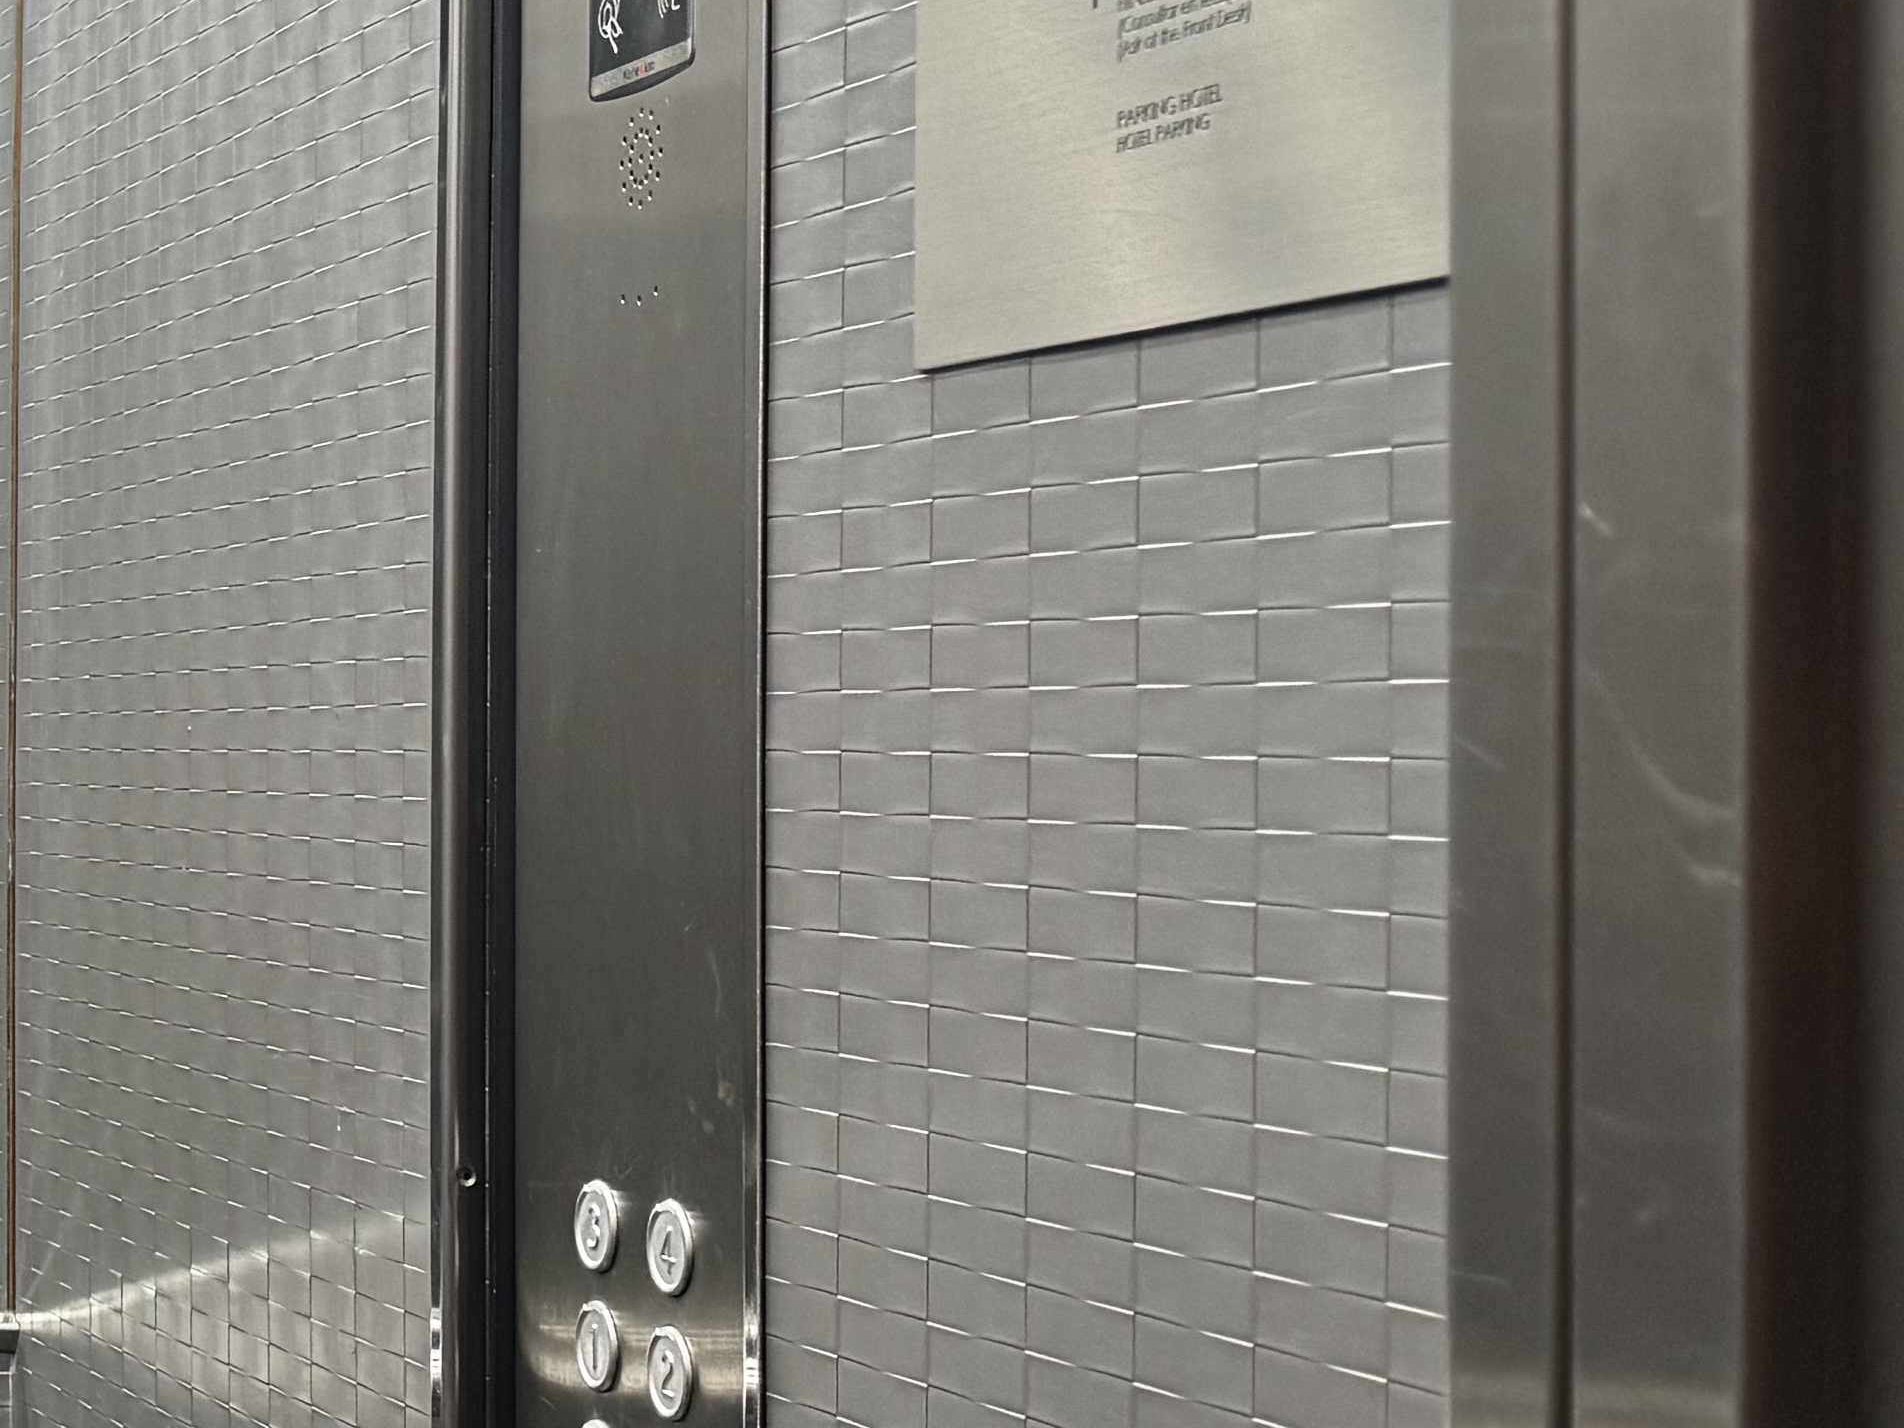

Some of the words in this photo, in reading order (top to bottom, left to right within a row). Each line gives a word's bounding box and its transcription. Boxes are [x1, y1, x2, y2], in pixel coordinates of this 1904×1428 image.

[1116, 96, 1177, 129] PARKING
[1178, 83, 1223, 112] HOTEL
[1116, 128, 1153, 153] HOTEL
[1154, 112, 1211, 142] PARKING
[585, 1202, 601, 1248] 3
[660, 1225, 677, 1275] 4
[661, 1349, 675, 1398] 2
